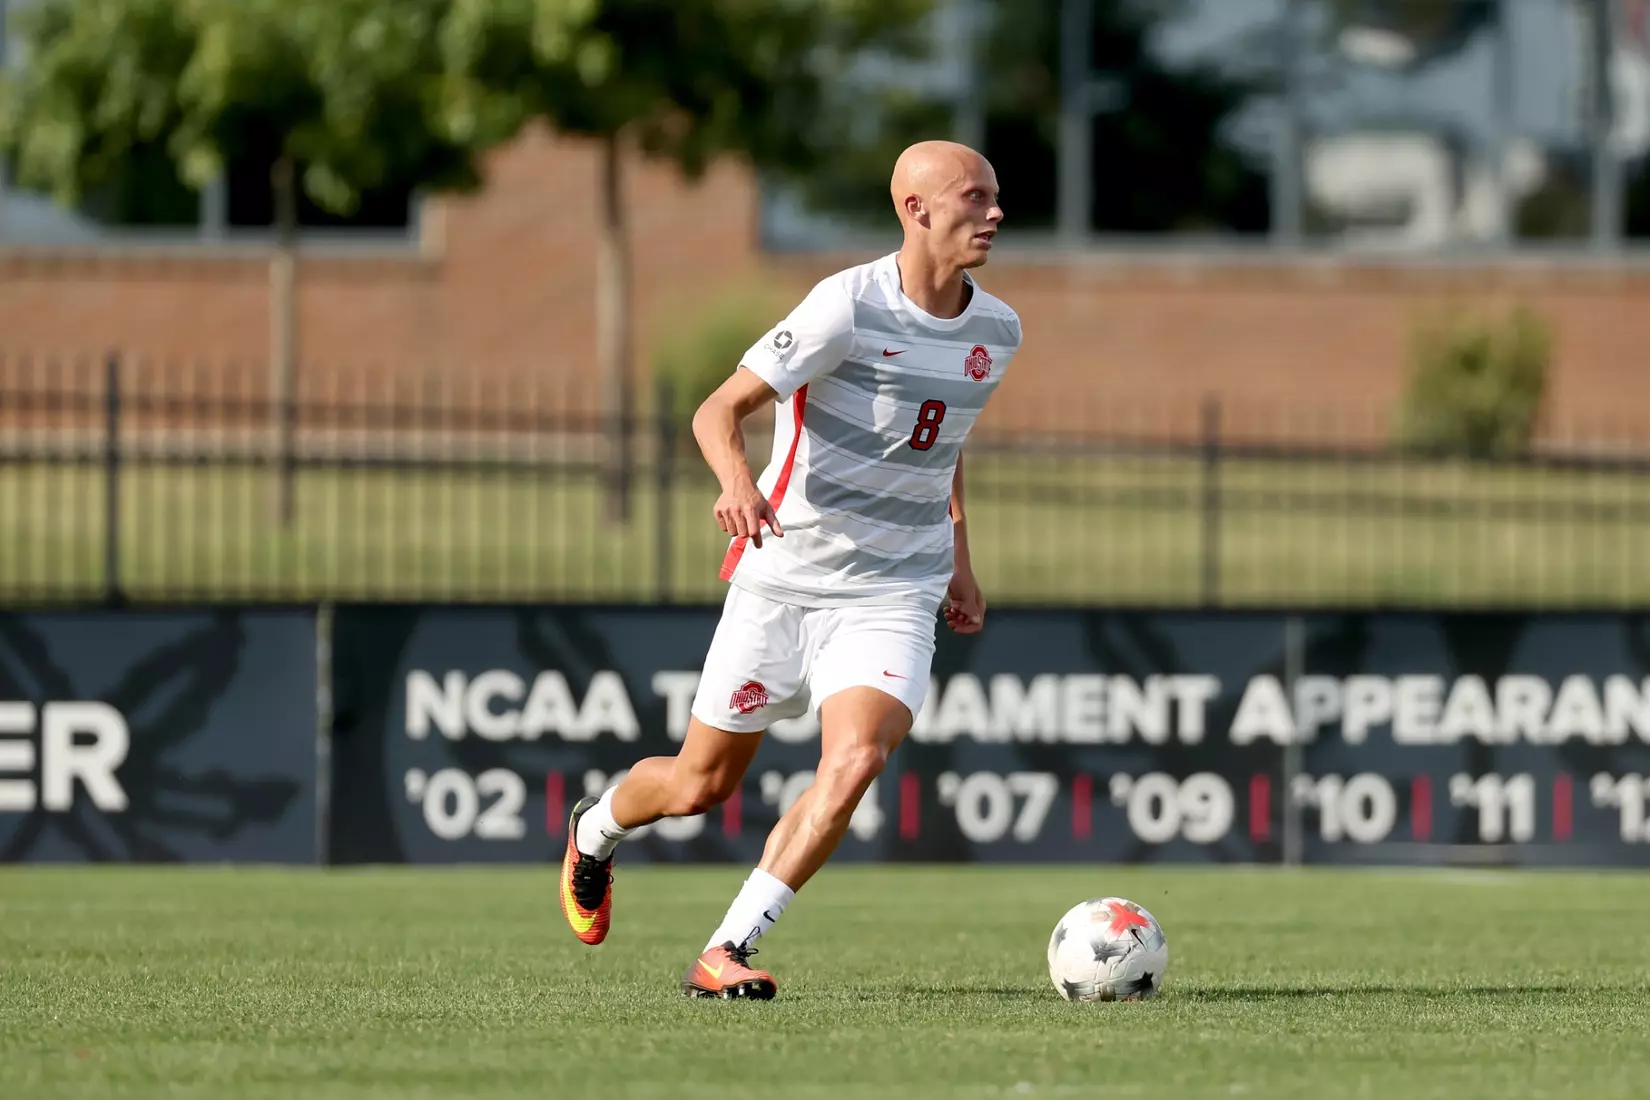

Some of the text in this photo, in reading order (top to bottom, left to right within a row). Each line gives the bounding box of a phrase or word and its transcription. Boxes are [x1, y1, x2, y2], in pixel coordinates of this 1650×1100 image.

[763, 343, 785, 360] CHASE
[908, 399, 947, 451] 8
[405, 669, 641, 741] NCAA
[651, 670, 1222, 744] TAMENT
